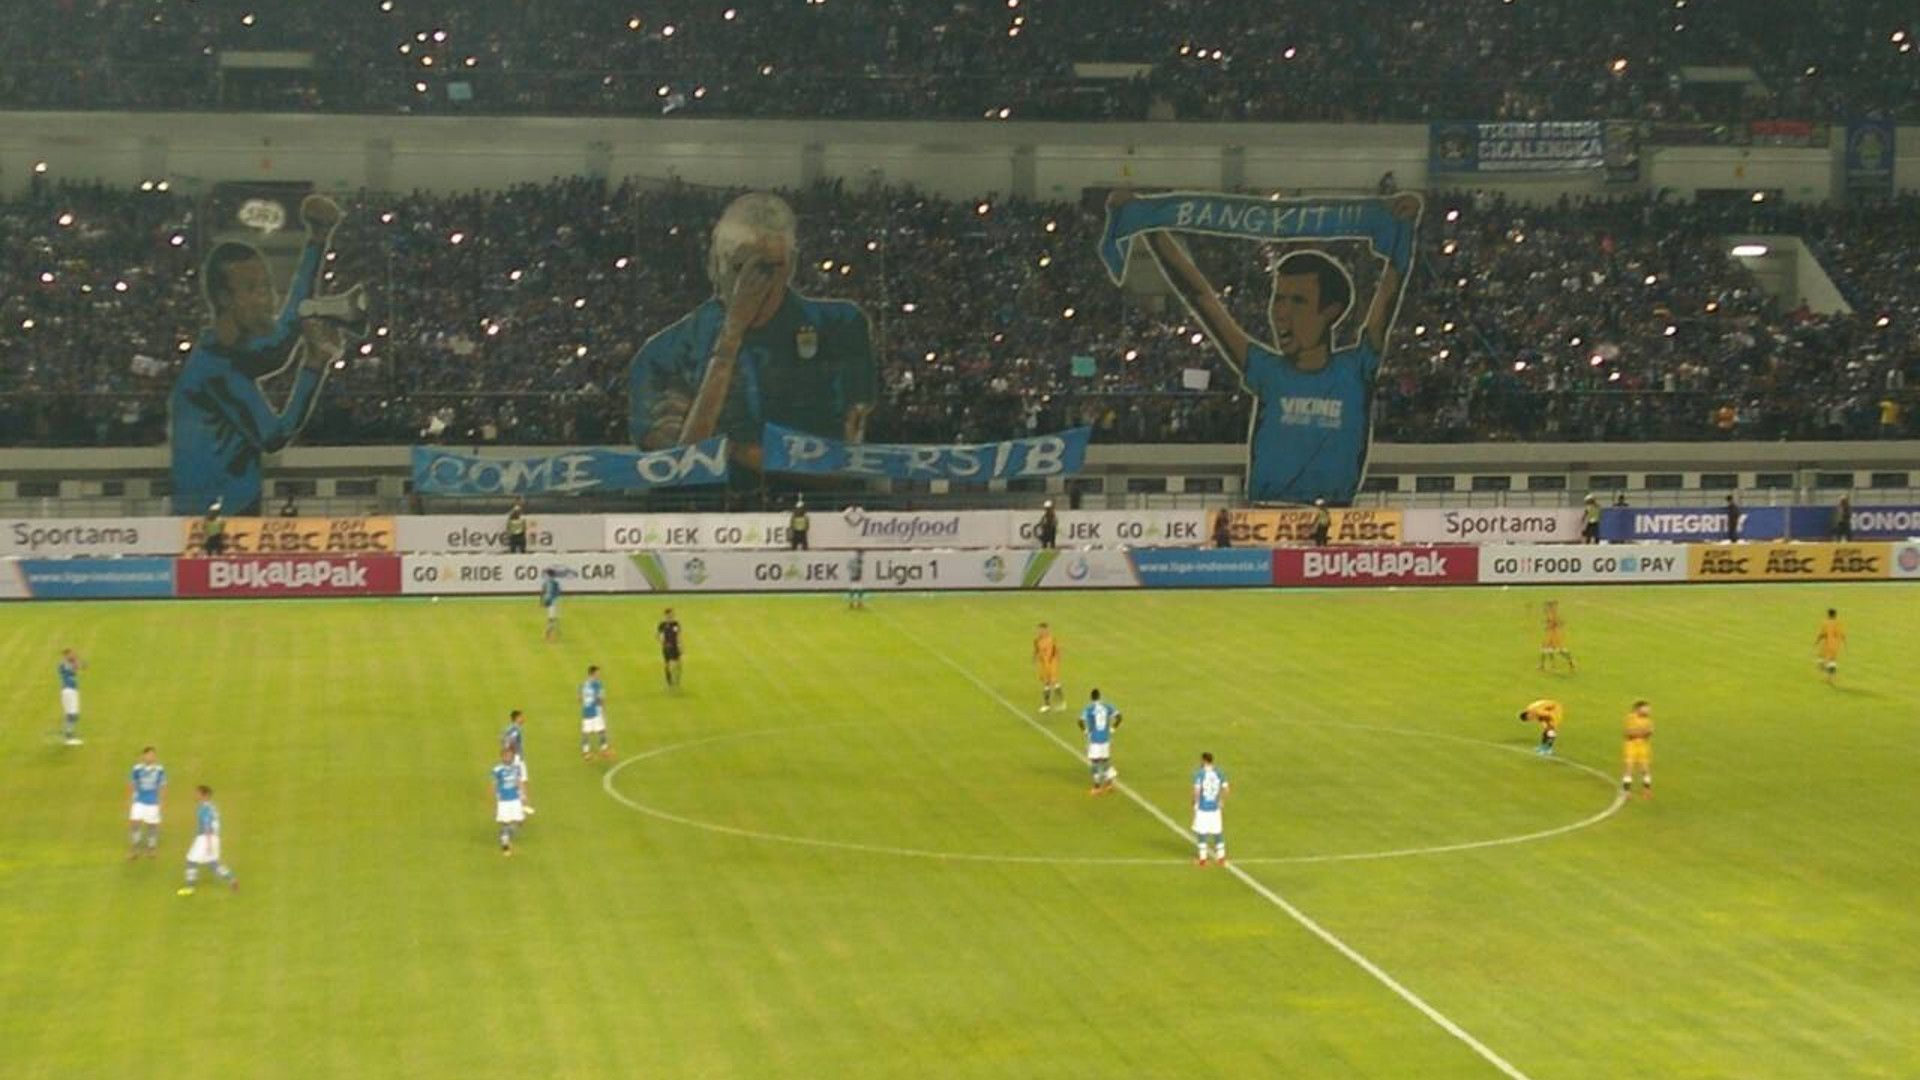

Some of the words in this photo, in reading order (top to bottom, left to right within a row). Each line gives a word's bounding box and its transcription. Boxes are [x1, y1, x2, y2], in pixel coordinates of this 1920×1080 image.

[1177, 202, 1329, 233] BANGKIT
[783, 434, 1065, 477] PERSIB
[429, 455, 602, 494] COME
[636, 438, 728, 483] ON
[447, 520, 553, 547] eleveia
[862, 516, 959, 544] Indofood
[1069, 522, 1101, 540] JEK
[1117, 522, 1142, 538] GO
[1164, 521, 1198, 539] JEK
[1338, 521, 1396, 540] ABC
[1445, 513, 1556, 537] Sportama
[13, 523, 139, 547] Sportama
[257, 532, 320, 551] ABC
[326, 531, 388, 549] ABC
[614, 528, 642, 545] GO
[665, 526, 698, 544] JEK
[715, 527, 743, 544] GO
[413, 567, 438, 582] GO
[461, 566, 503, 582] RIDE
[515, 565, 538, 581] GO
[582, 565, 615, 580] CAR
[755, 564, 783, 581] GO
[805, 563, 839, 580] JEK
[875, 561, 922, 584] Liga
[930, 560, 938, 577] 1
[1494, 558, 1517, 573] GO
[1534, 558, 1582, 573] FOOD
[1593, 558, 1617, 573] GO
[1640, 557, 1675, 573] PAY
[1700, 558, 1749, 574] ABC
[1765, 558, 1815, 573] ABC
[1830, 556, 1879, 573] ABC
